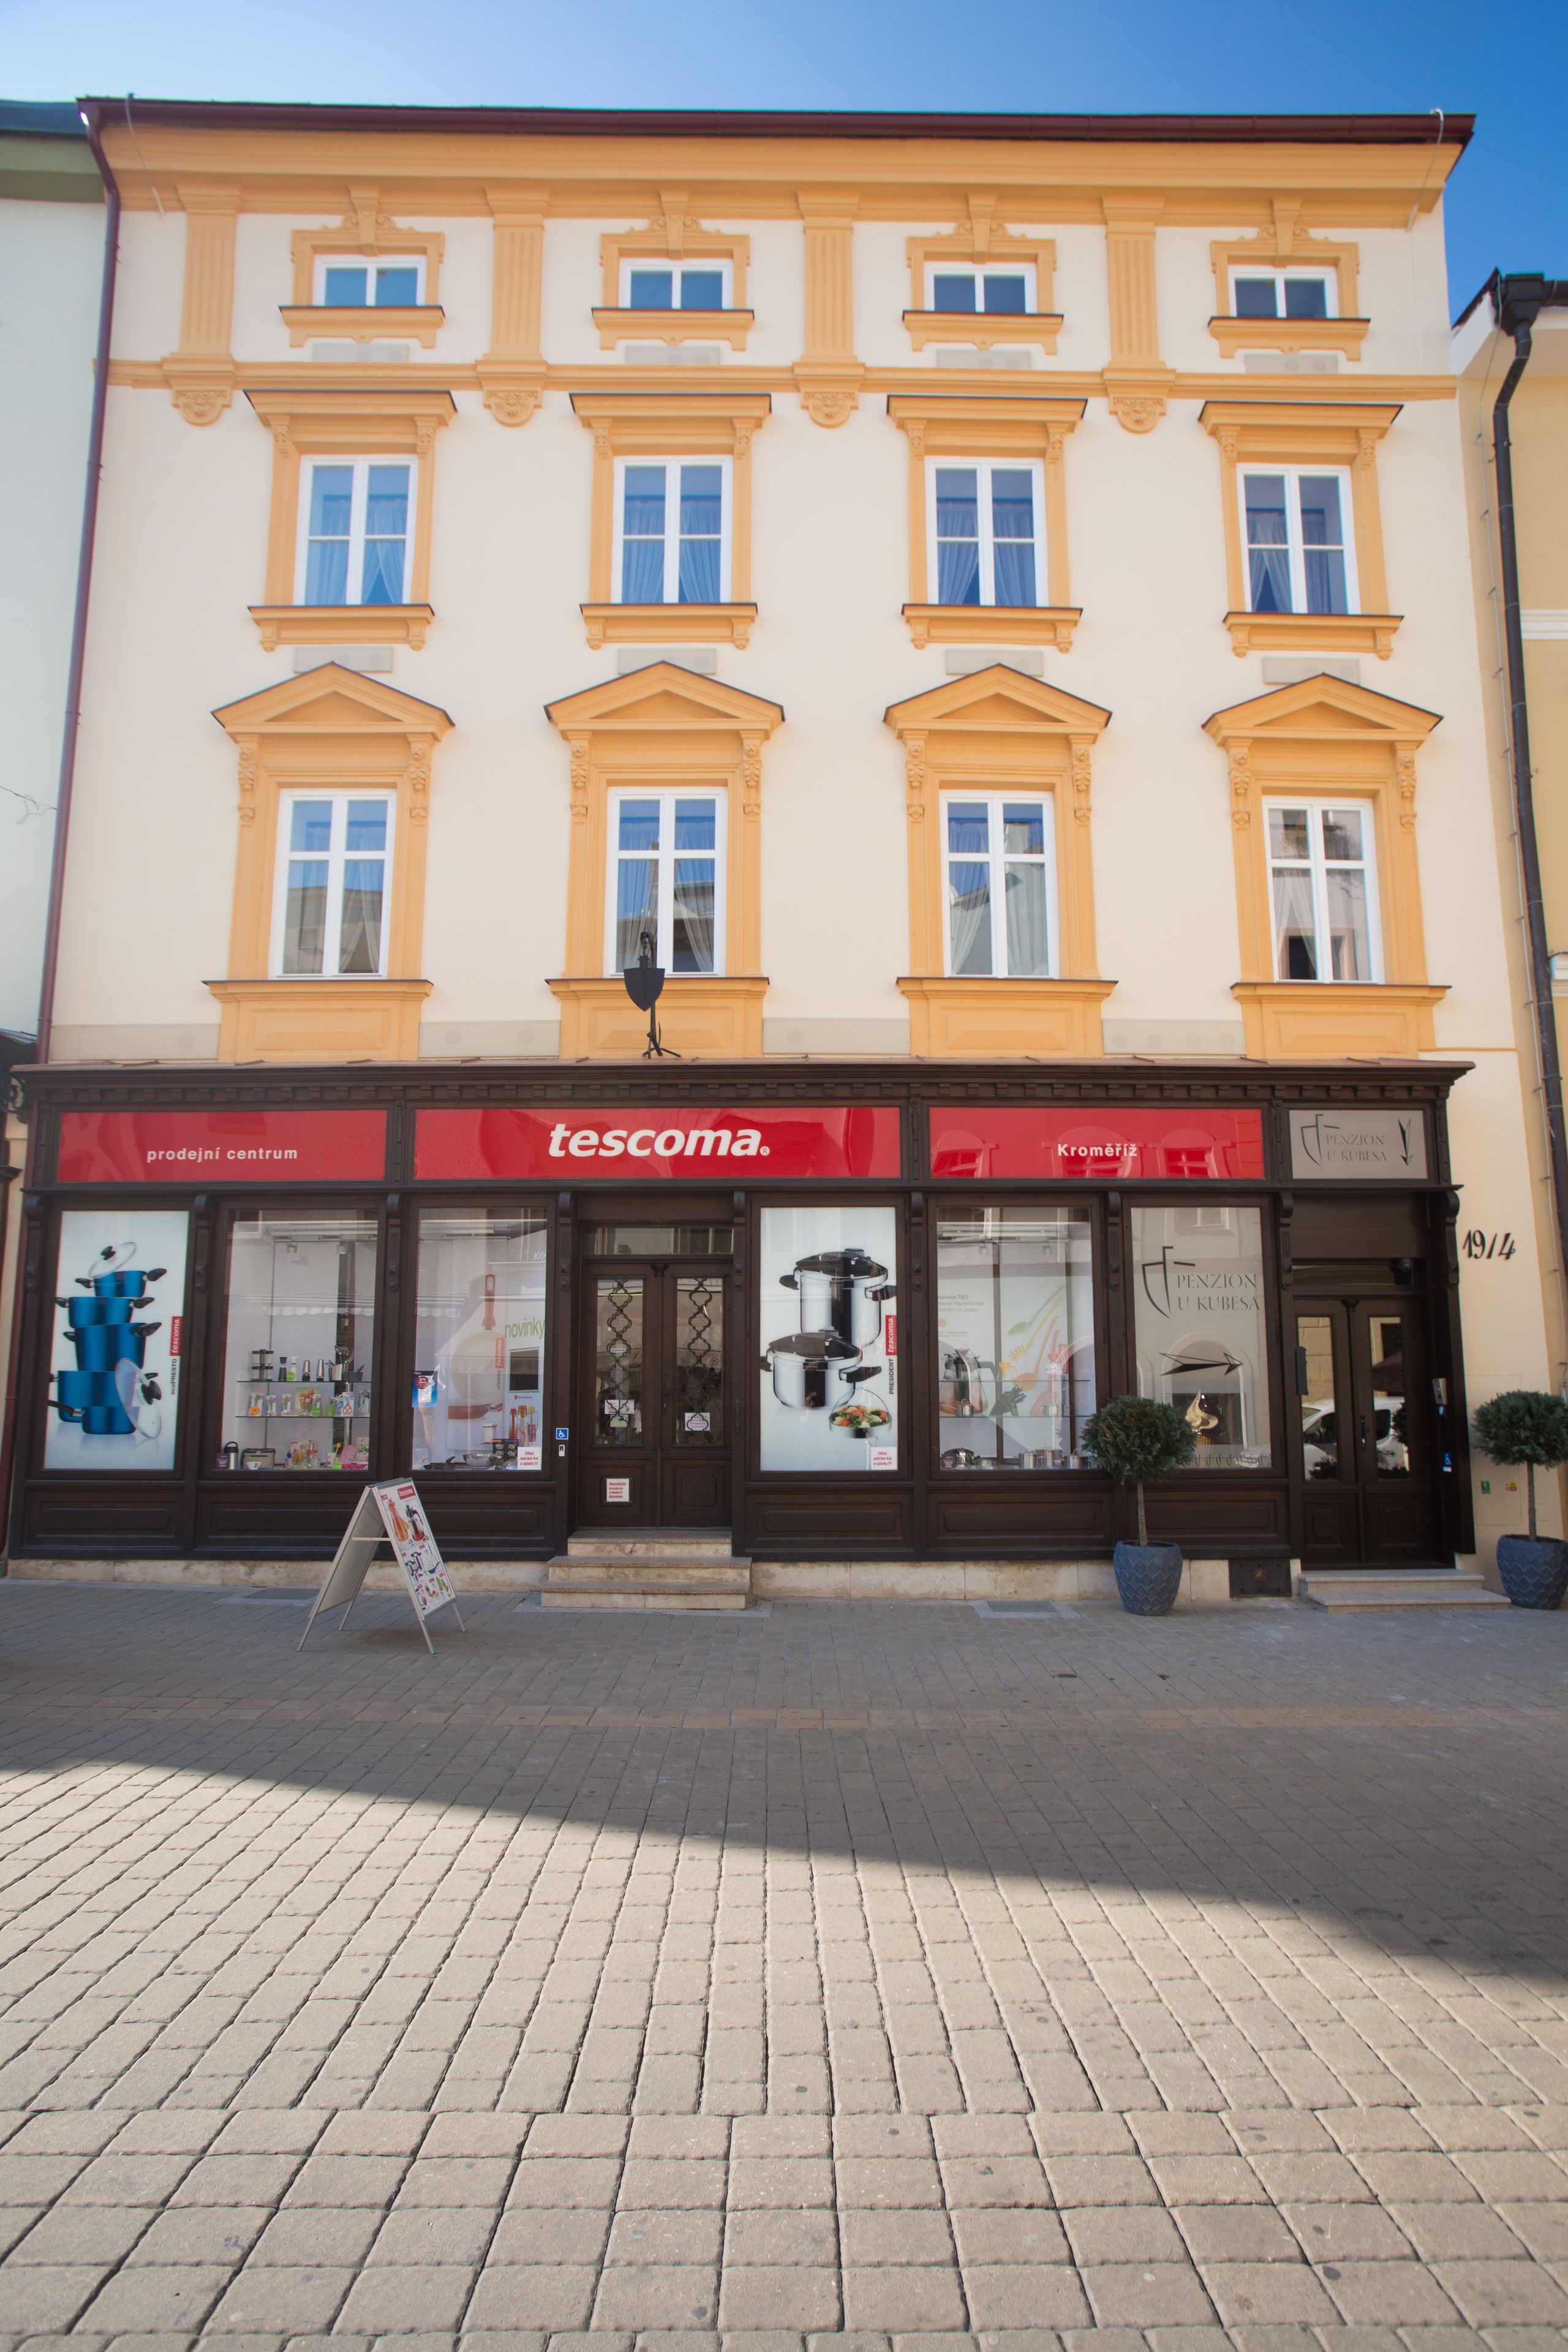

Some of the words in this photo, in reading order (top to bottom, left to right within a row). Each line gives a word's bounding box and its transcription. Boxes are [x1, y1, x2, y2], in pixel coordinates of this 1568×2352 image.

[1326, 1134, 1385, 1145] PENZION
[146, 1147, 221, 1163] prodejní
[226, 1148, 298, 1159] centrum
[1057, 1143, 1137, 1156] Kroměříž
[1327, 1150, 1336, 1161] U
[1341, 1150, 1387, 1161] KUBESA
[1462, 1230, 1516, 1261] 19/4
[1177, 1273, 1257, 1289] PENZION
[1178, 1296, 1189, 1311] U
[1197, 1295, 1260, 1311] KUBESA
[505, 1316, 545, 1340] novinky
